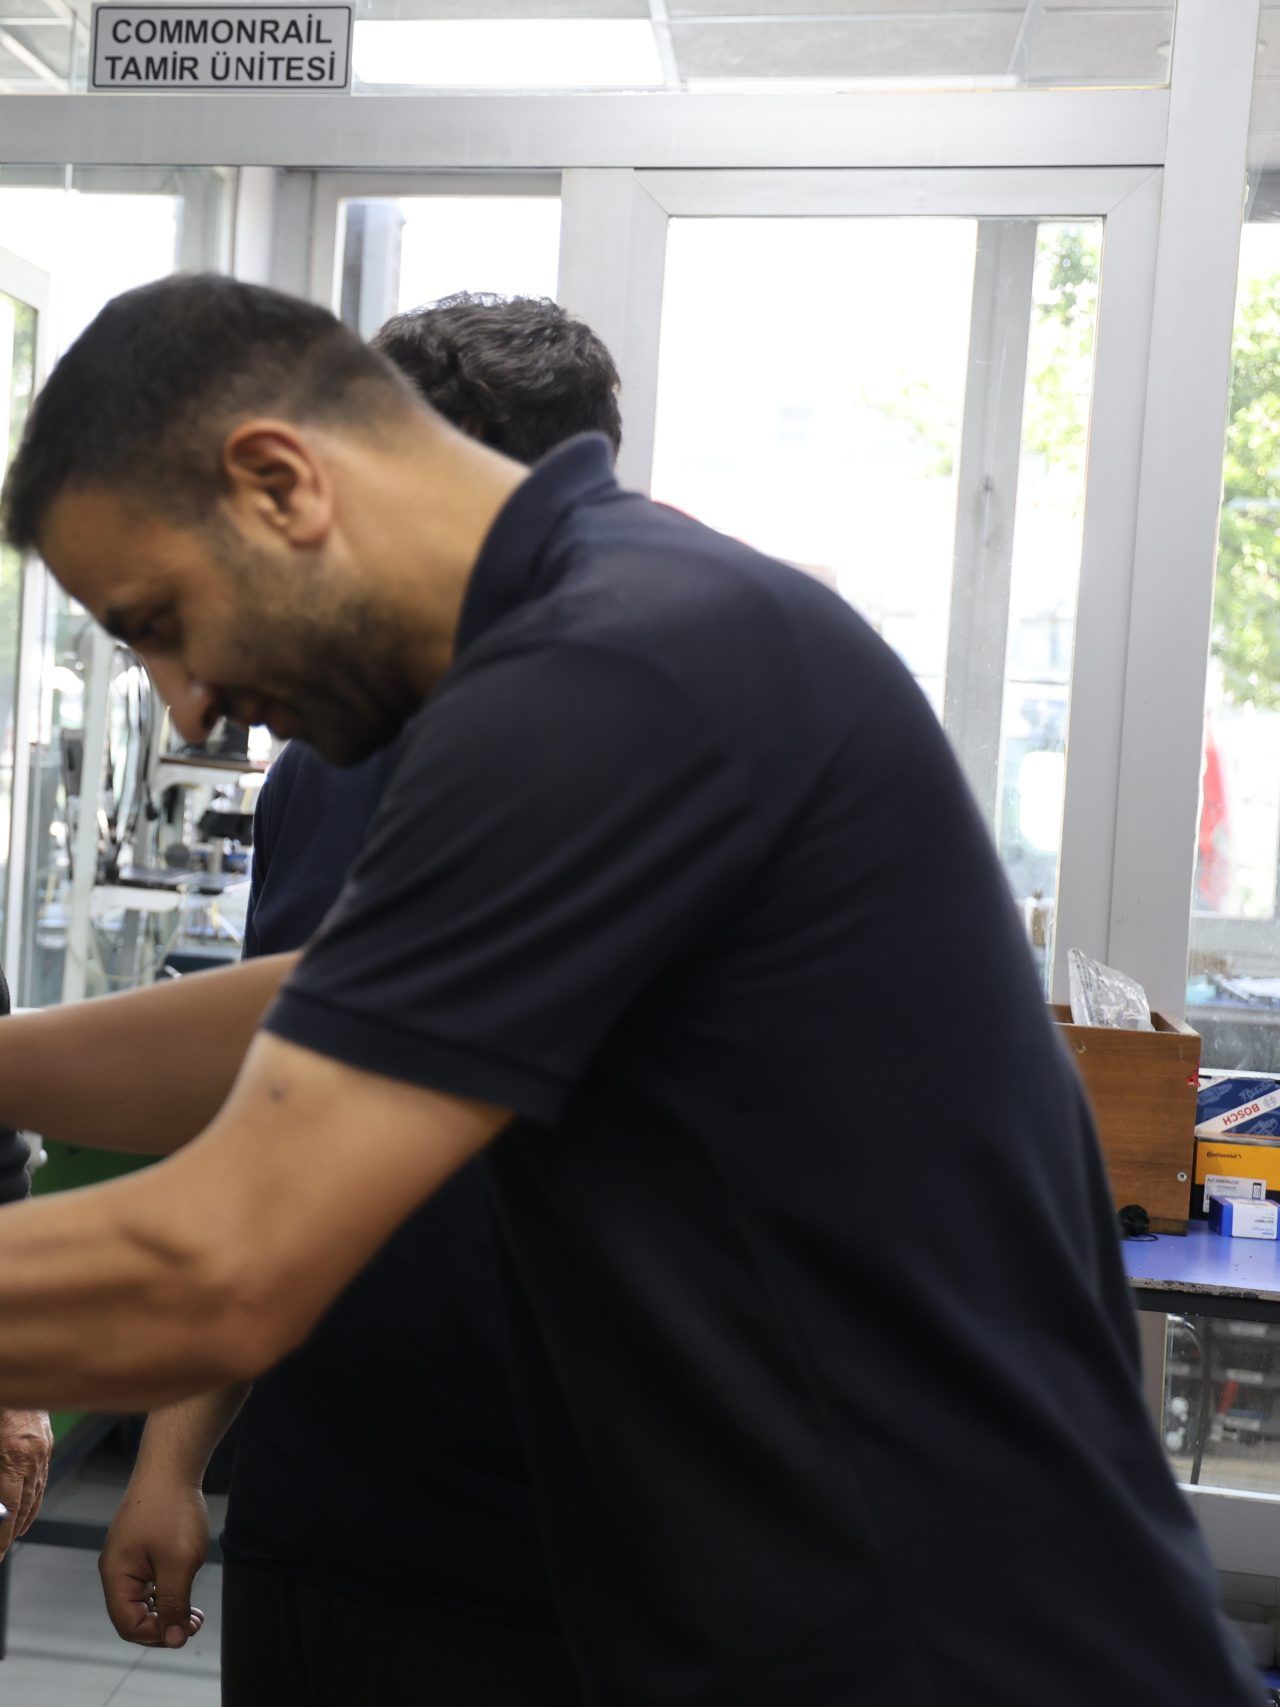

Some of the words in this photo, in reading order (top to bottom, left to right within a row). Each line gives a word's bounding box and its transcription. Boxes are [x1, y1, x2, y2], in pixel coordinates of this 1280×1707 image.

[111, 13, 333, 44] COMMONRAİL
[104, 51, 199, 81] TAMİR
[210, 51, 335, 81] ÜNİTESİ
[1222, 1103, 1261, 1126] BOSCH
